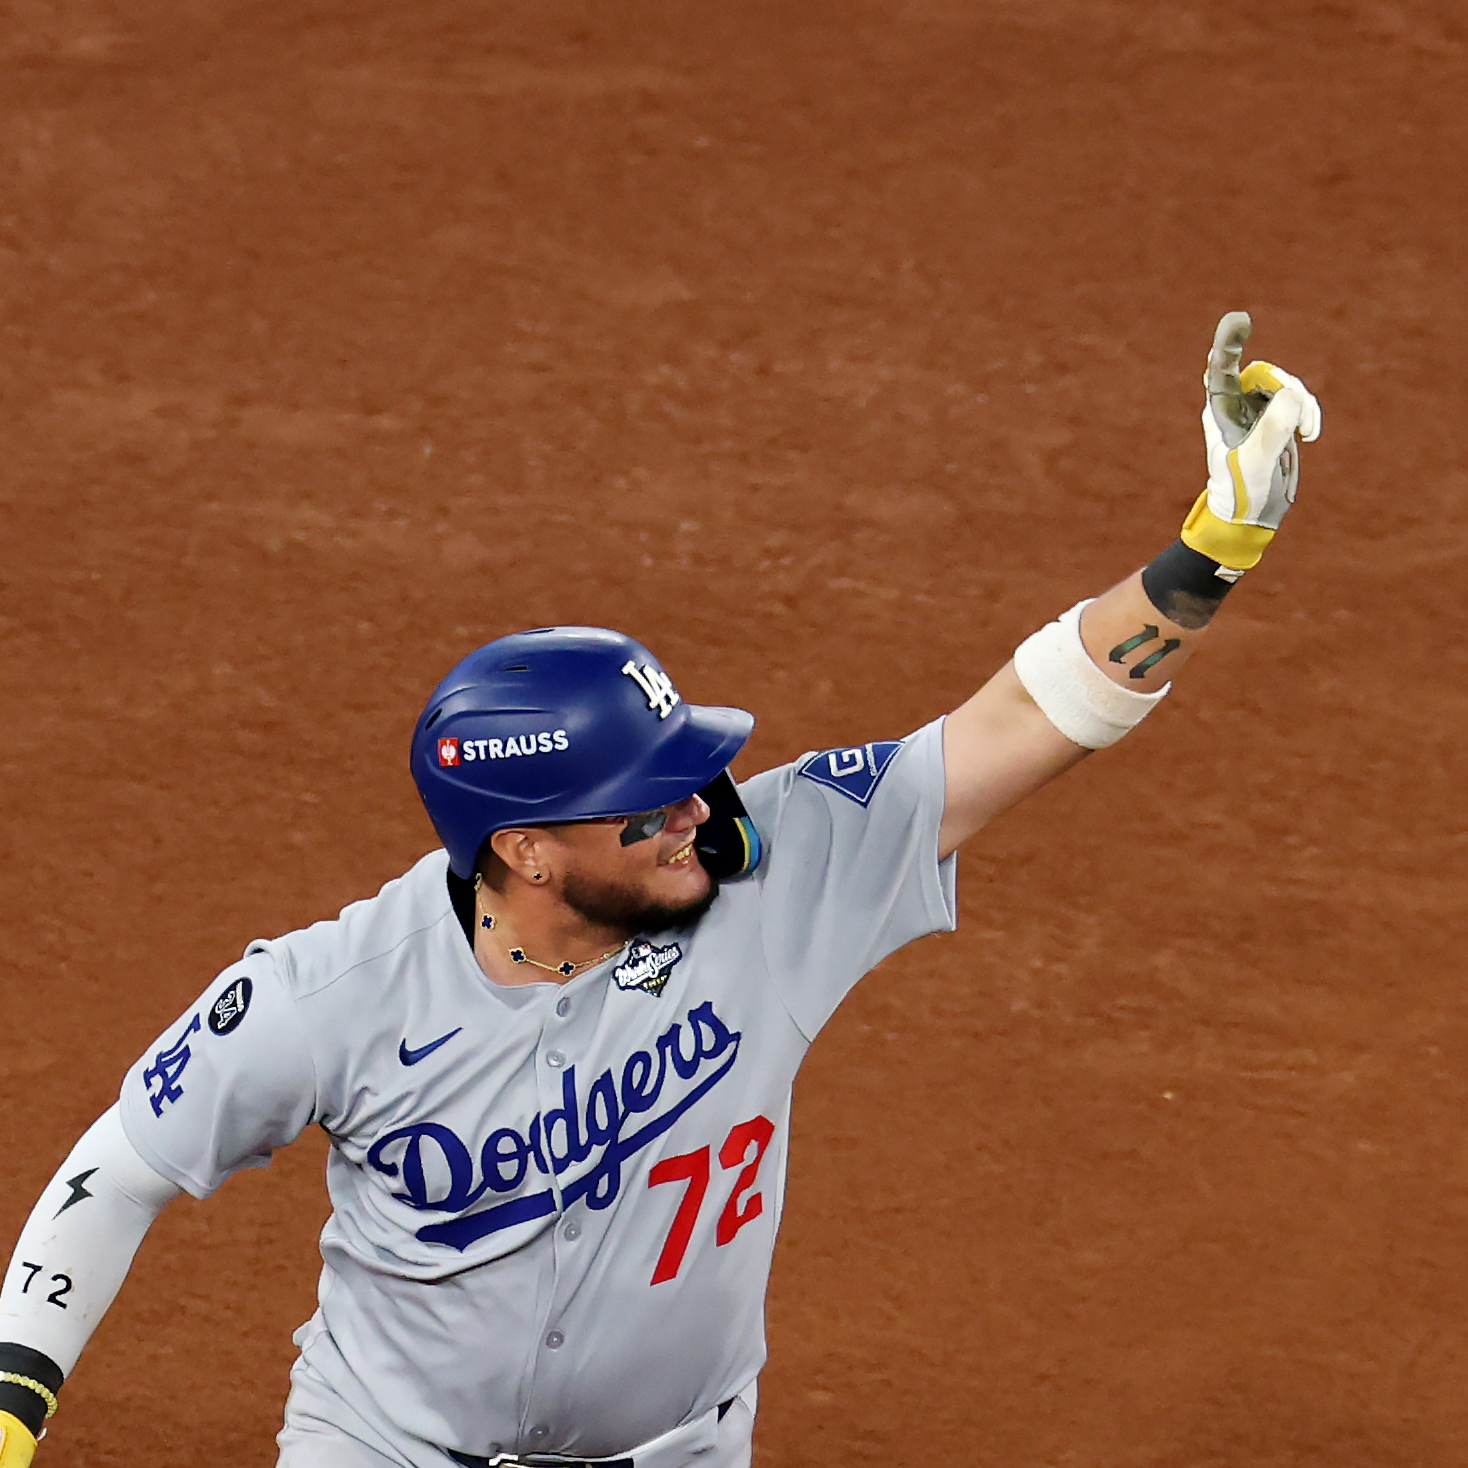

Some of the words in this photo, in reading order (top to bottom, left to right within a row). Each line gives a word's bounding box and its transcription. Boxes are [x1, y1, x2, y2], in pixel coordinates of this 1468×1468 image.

[621, 660, 680, 720] LA
[462, 729, 569, 762] STRAUSS
[828, 748, 865, 777] G
[143, 1012, 201, 1119] LA
[367, 1001, 741, 1215] Dodgers
[647, 1114, 775, 1287] 72
[22, 1261, 73, 1310] 72
